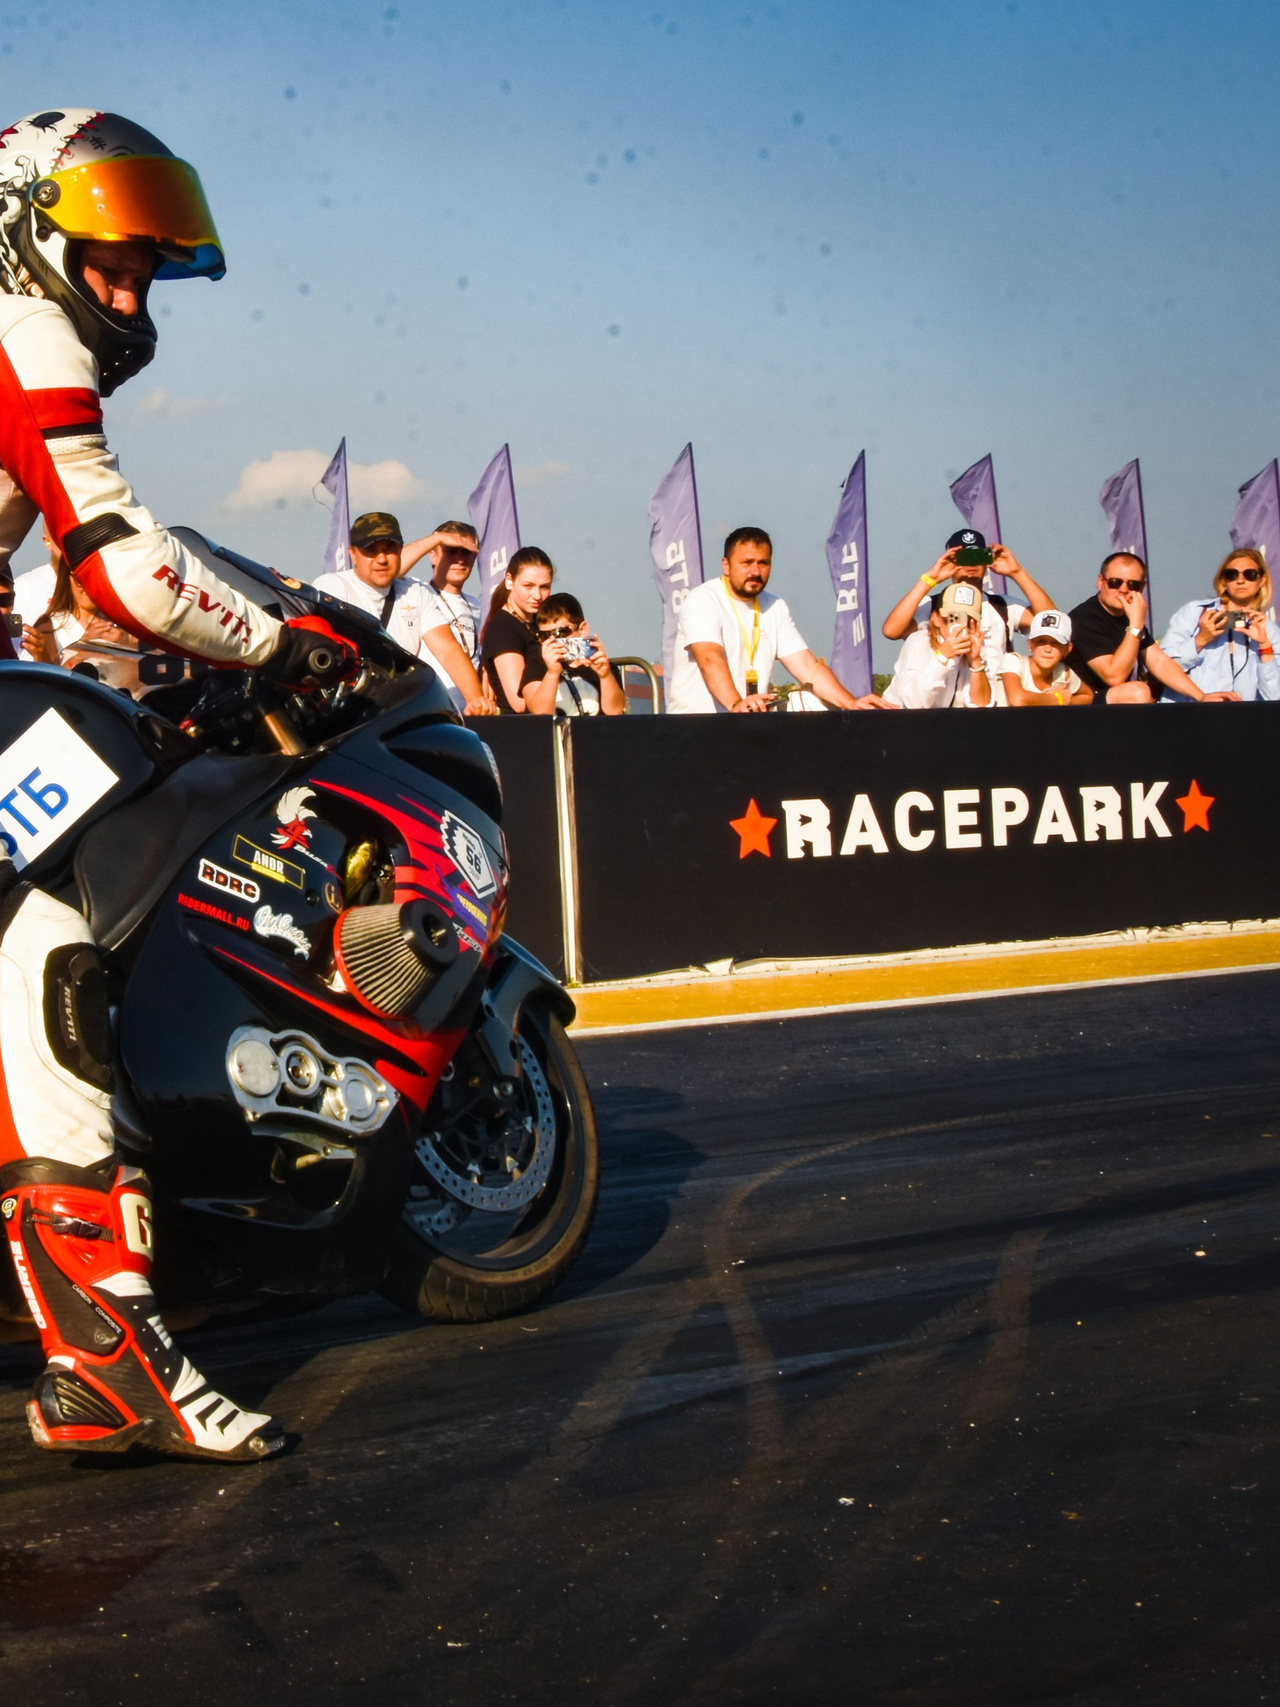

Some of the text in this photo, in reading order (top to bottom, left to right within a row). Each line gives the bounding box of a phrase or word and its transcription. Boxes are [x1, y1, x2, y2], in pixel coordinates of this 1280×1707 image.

[152, 564, 253, 644] REV'IT!
[781, 781, 1172, 859] RACEPARK
[201, 863, 257, 898] RDRC
[253, 850, 285, 875] ANDR
[177, 893, 251, 931] RIDERMALL.RU
[72, 1283, 122, 1334] CARBON COMPOSITE
